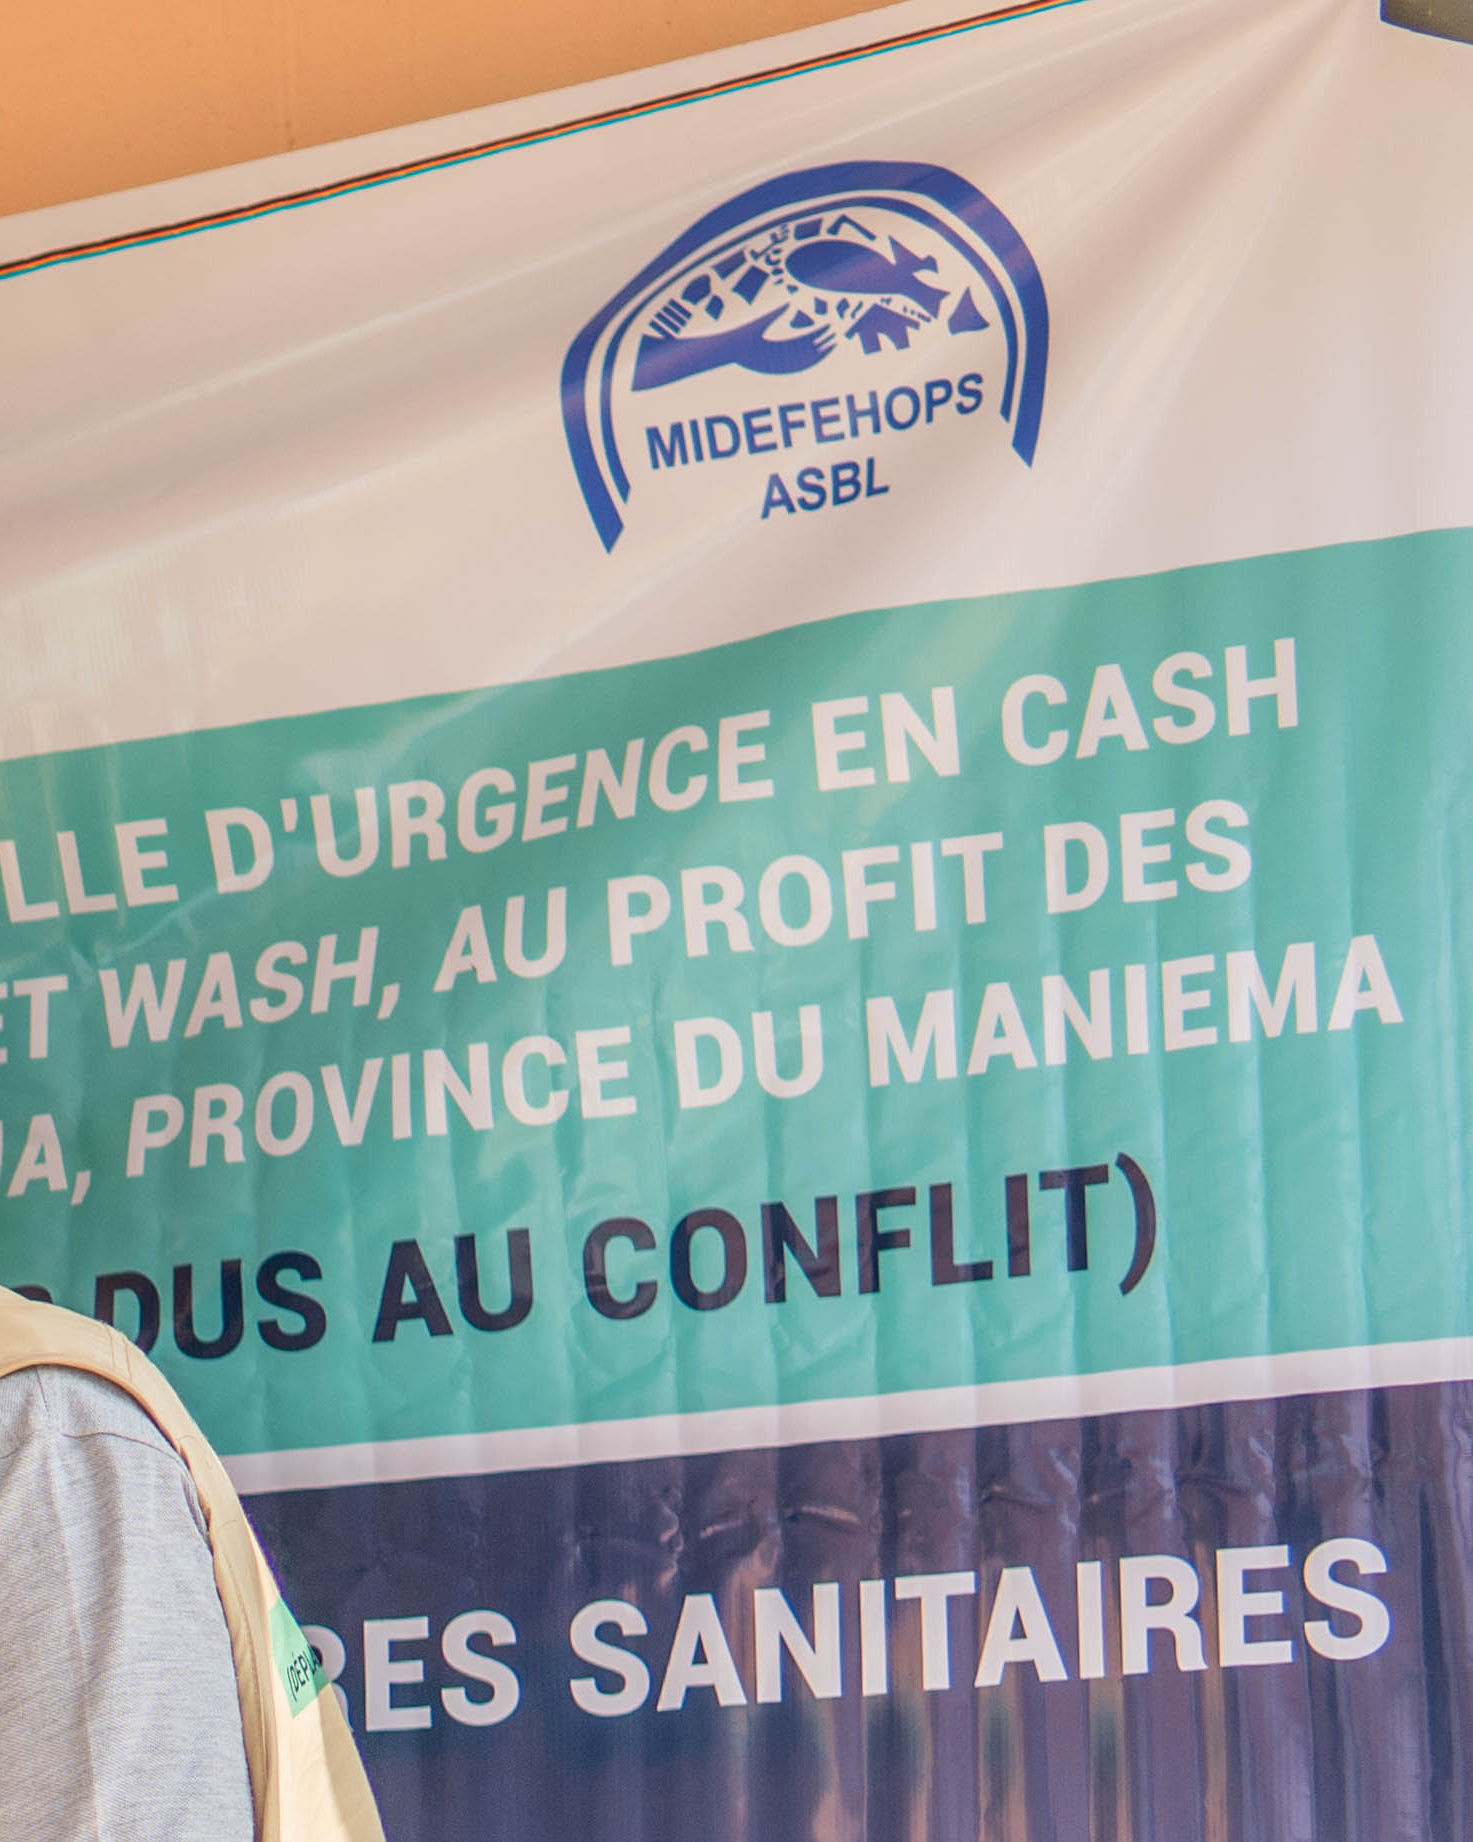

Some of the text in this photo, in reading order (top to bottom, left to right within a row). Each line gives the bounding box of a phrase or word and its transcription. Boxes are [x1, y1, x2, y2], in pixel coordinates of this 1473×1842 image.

[645, 372, 984, 471] MIDEFEHOPS
[761, 456, 890, 520] ASBL
[205, 709, 775, 895] D'URGENCE
[811, 685, 961, 792] EN
[1001, 636, 1300, 767] CASH
[99, 926, 401, 1049] WASH,
[432, 886, 569, 993] AU
[607, 831, 1004, 966] PROFIT
[1043, 799, 1253, 915] DES
[126, 1026, 638, 1178] PROVINCE
[674, 1004, 824, 1111] DU
[866, 934, 1405, 1089] MANIEMA
[372, 1227, 536, 1345] AU
[583, 1150, 1157, 1321] CONFLIT)
[569, 1536, 1391, 1719] SANITAIRES
